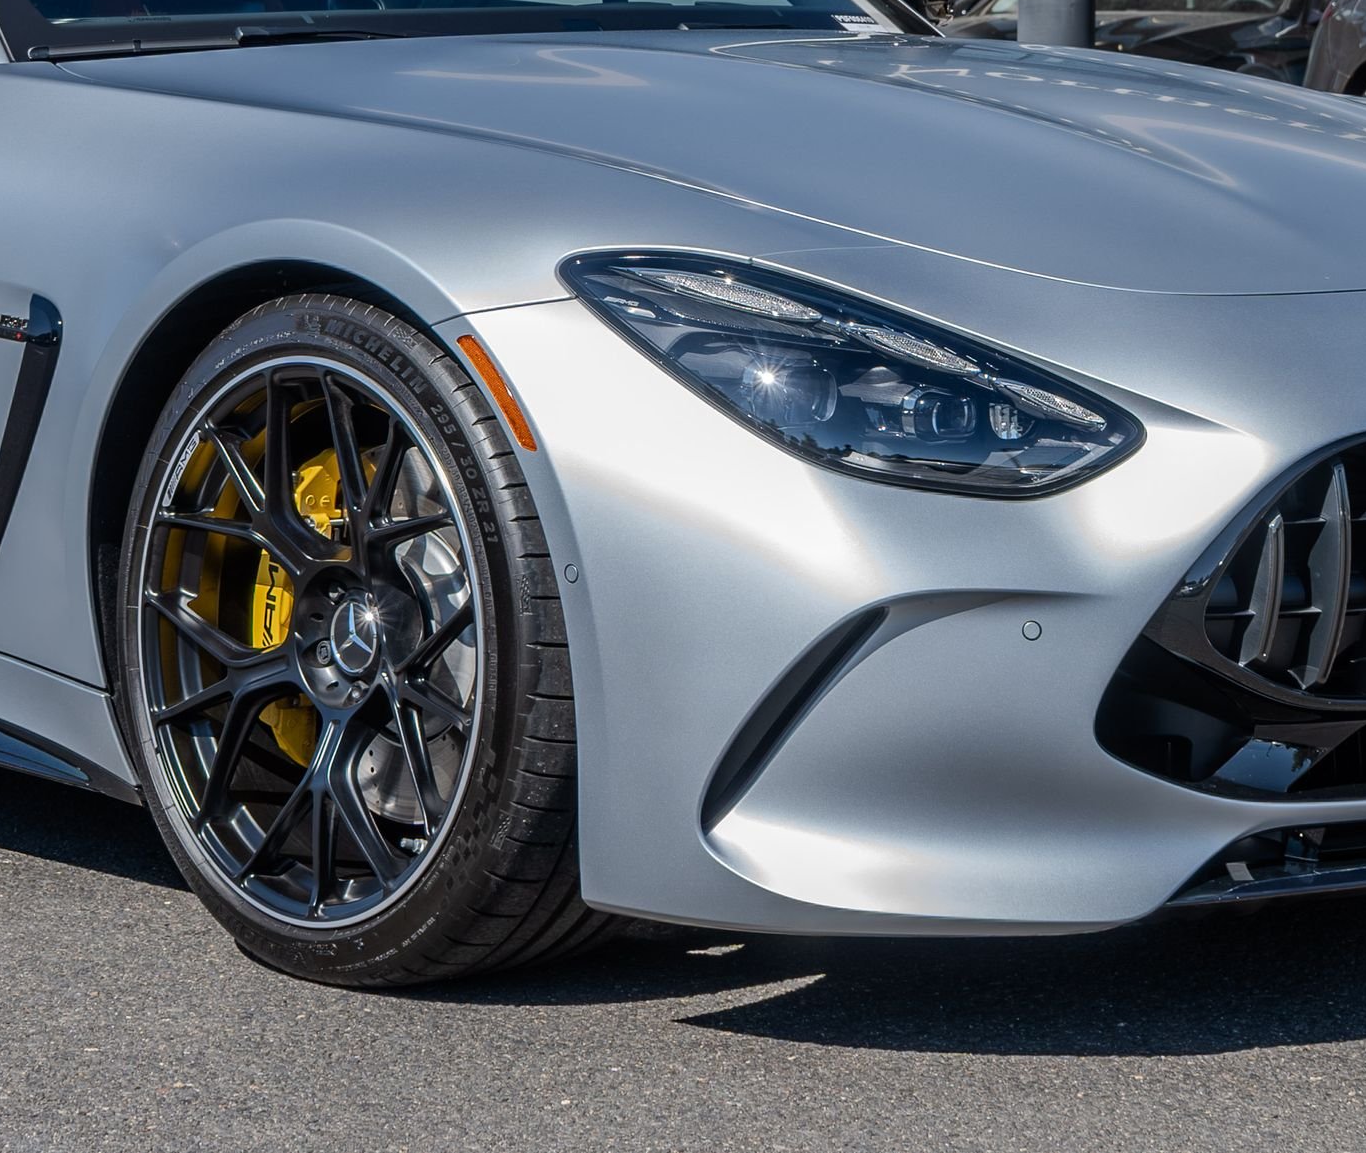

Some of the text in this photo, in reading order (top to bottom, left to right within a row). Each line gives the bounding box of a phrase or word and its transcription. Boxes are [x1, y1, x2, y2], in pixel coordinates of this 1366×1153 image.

[170, 438, 198, 488] AMG
[324, 318, 429, 395] MICHELIN
[430, 403, 457, 435] 295
[460, 456, 478, 481] 30
[472, 487, 491, 514] ZR
[482, 521, 499, 544] 21
